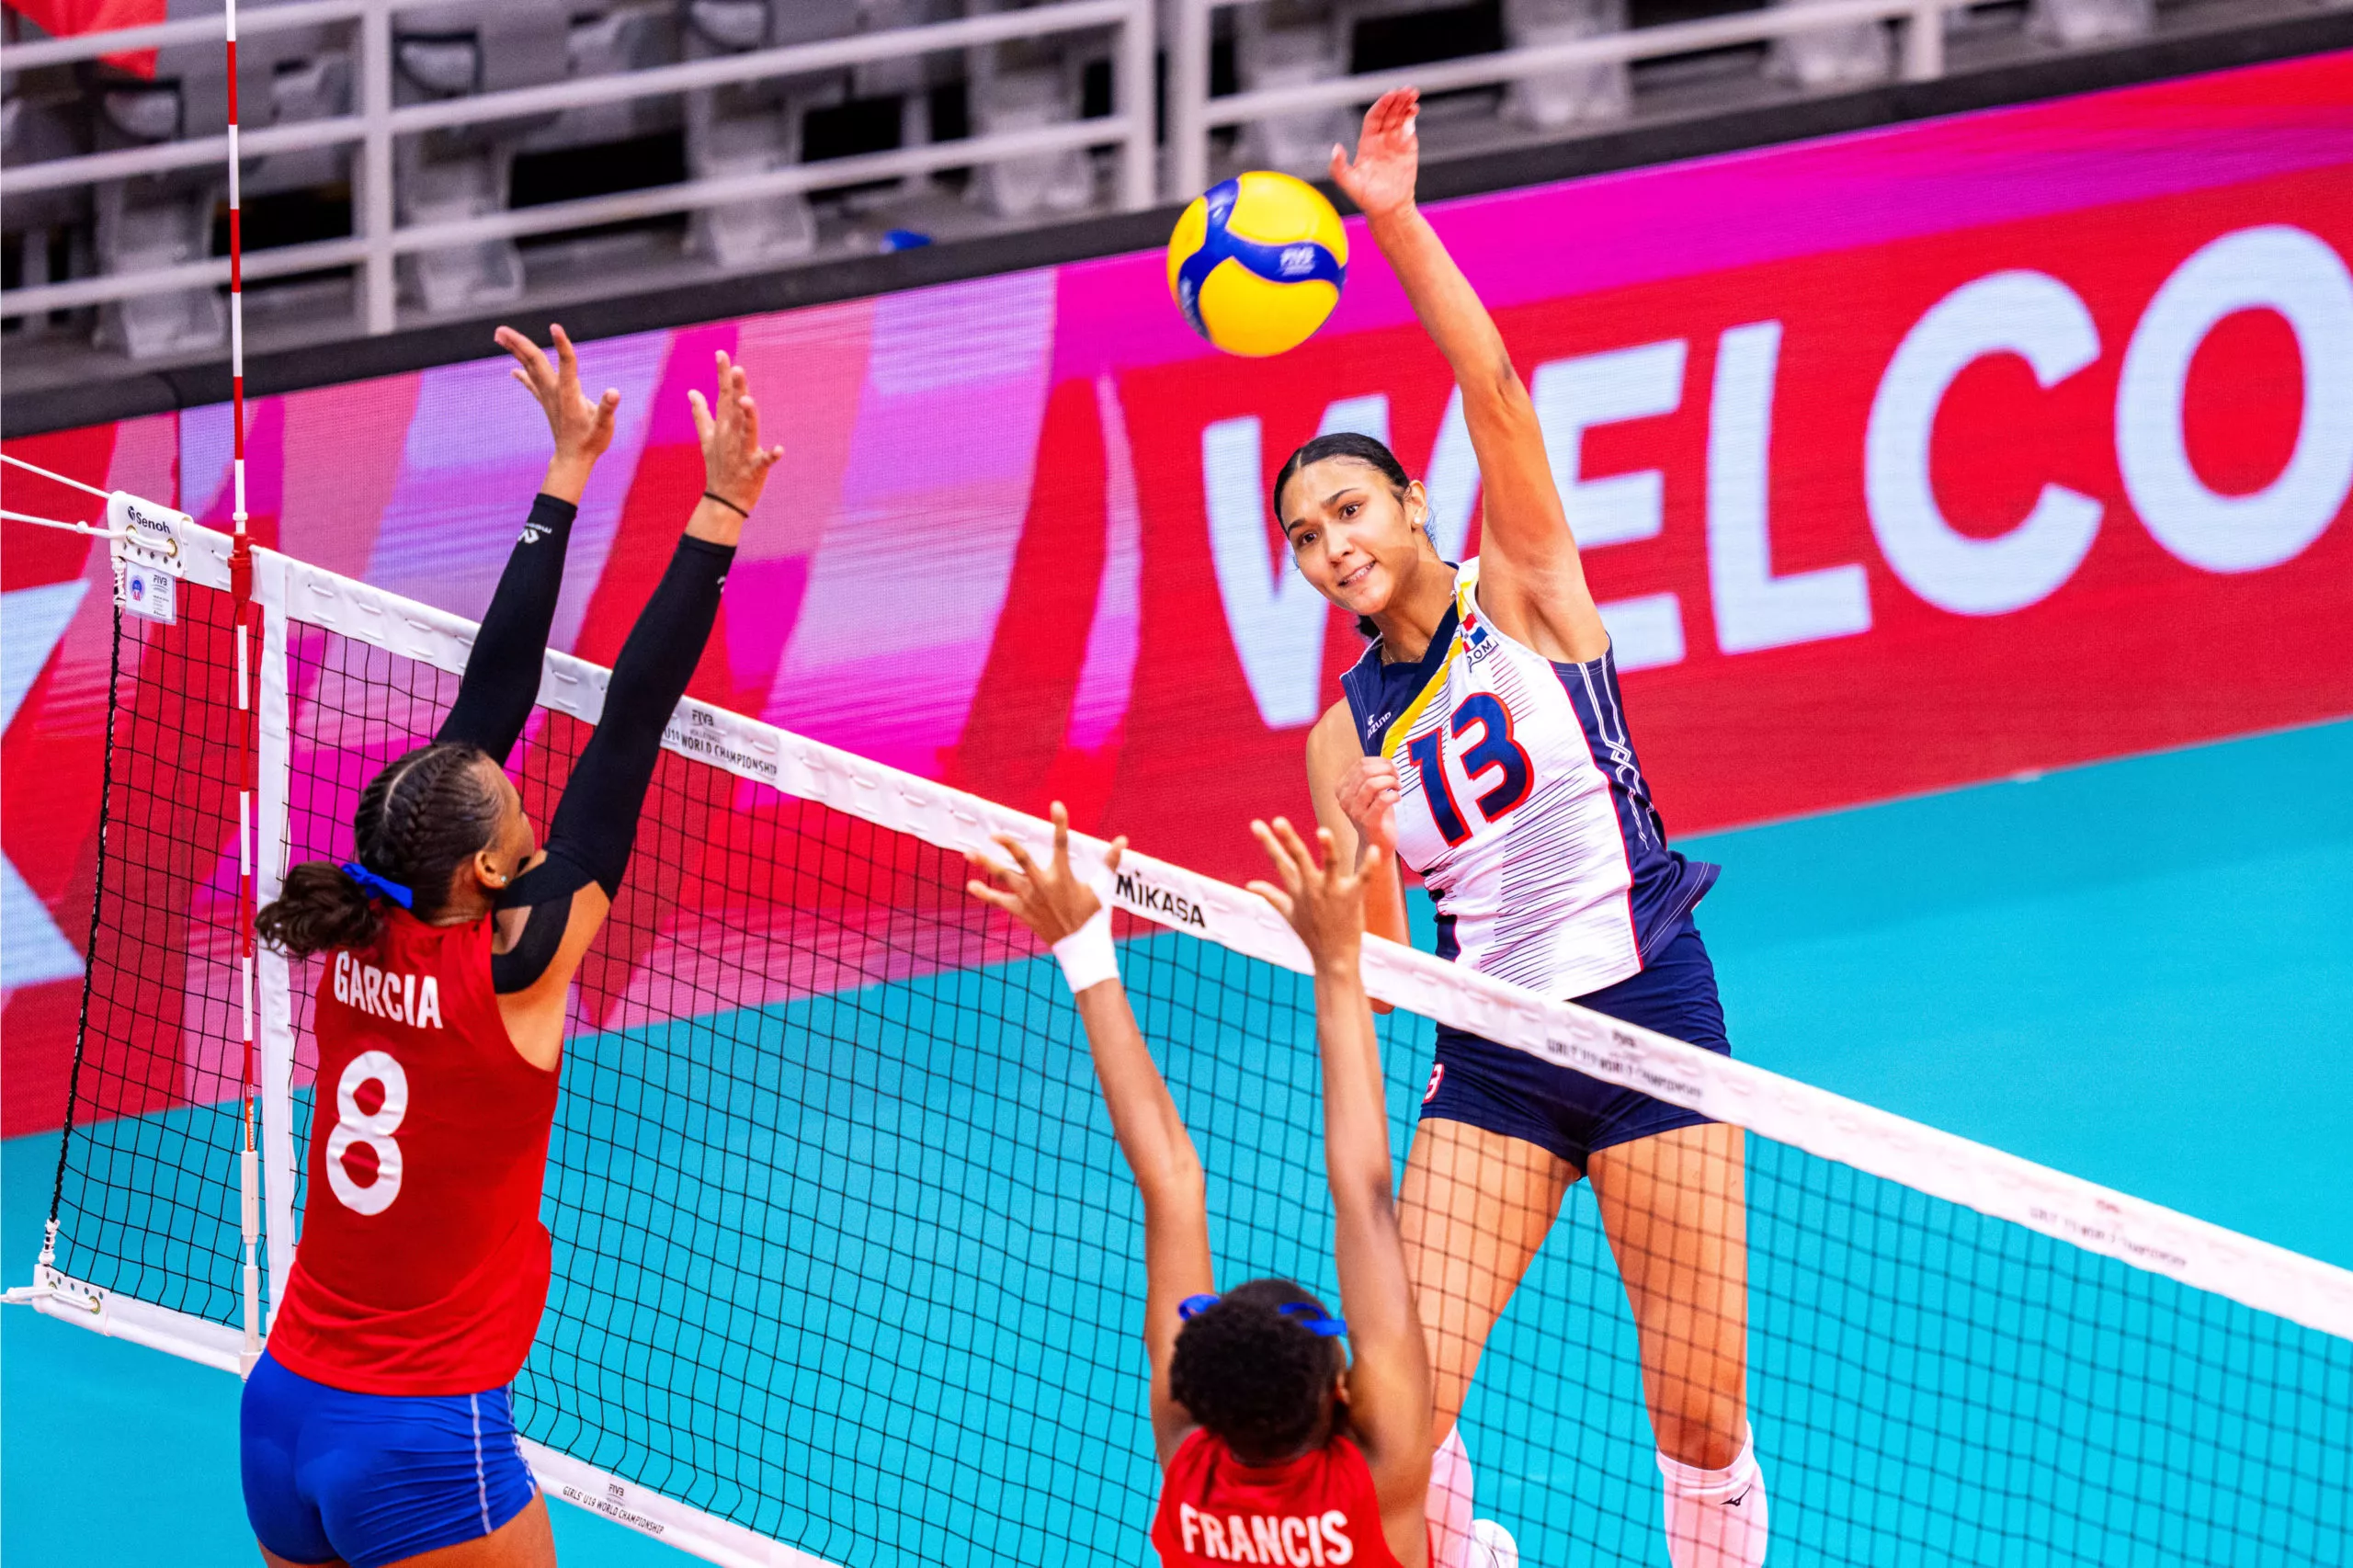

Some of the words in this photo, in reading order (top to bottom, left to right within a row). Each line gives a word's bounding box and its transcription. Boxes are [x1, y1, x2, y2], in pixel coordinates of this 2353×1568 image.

[136, 512, 171, 535] Senoh
[153, 574, 167, 586] FIVB
[692, 710, 714, 727] FIVB
[681, 736, 712, 754] WORLD
[1406, 691, 1535, 848] 13
[1116, 870, 1206, 928] MIKASA
[334, 950, 443, 1029] GARCIA
[325, 1050, 408, 1216] 8
[608, 1483, 625, 1497] FIVB
[583, 1495, 597, 1507] U19
[597, 1500, 619, 1517] WORLD
[619, 1509, 665, 1535] CHAMPIONSHIP
[1179, 1502, 1354, 1568] FRANCIS
